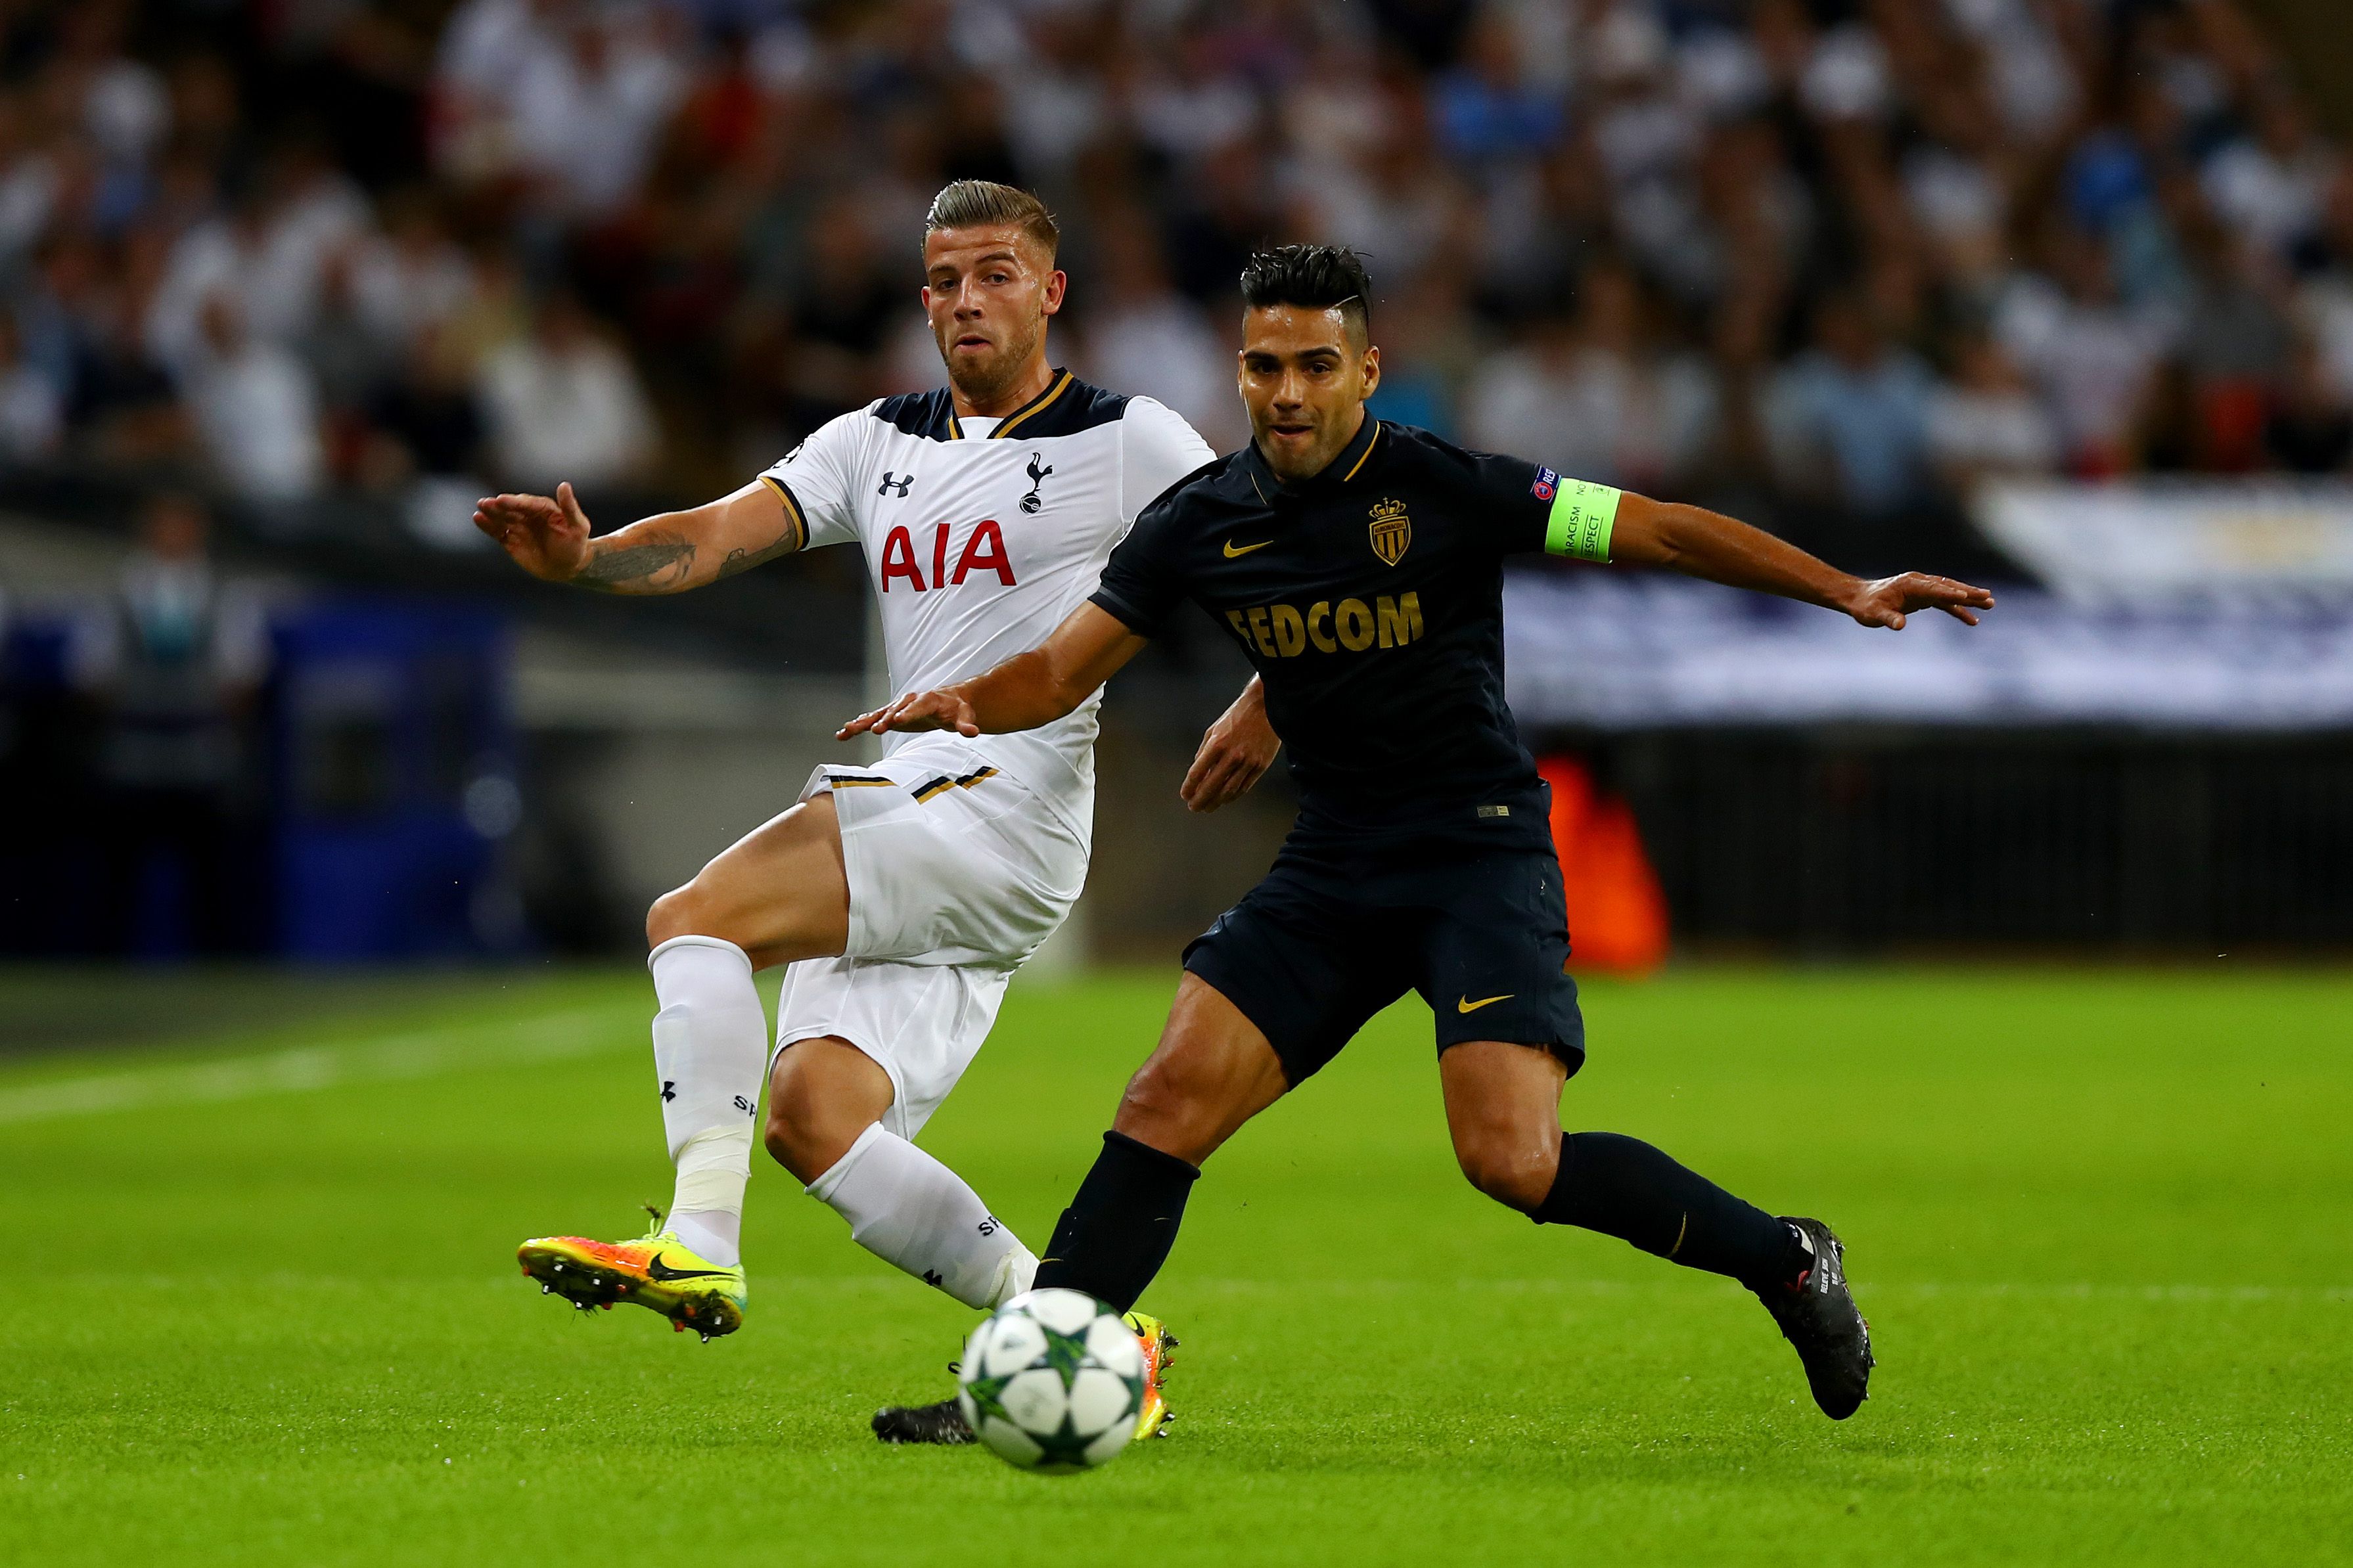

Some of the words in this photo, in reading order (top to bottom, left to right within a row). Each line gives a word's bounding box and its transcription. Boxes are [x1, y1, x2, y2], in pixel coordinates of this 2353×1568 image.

[1565, 506, 1581, 547] RACISM
[1576, 483, 1586, 495] NO
[881, 520, 1017, 593] AIA
